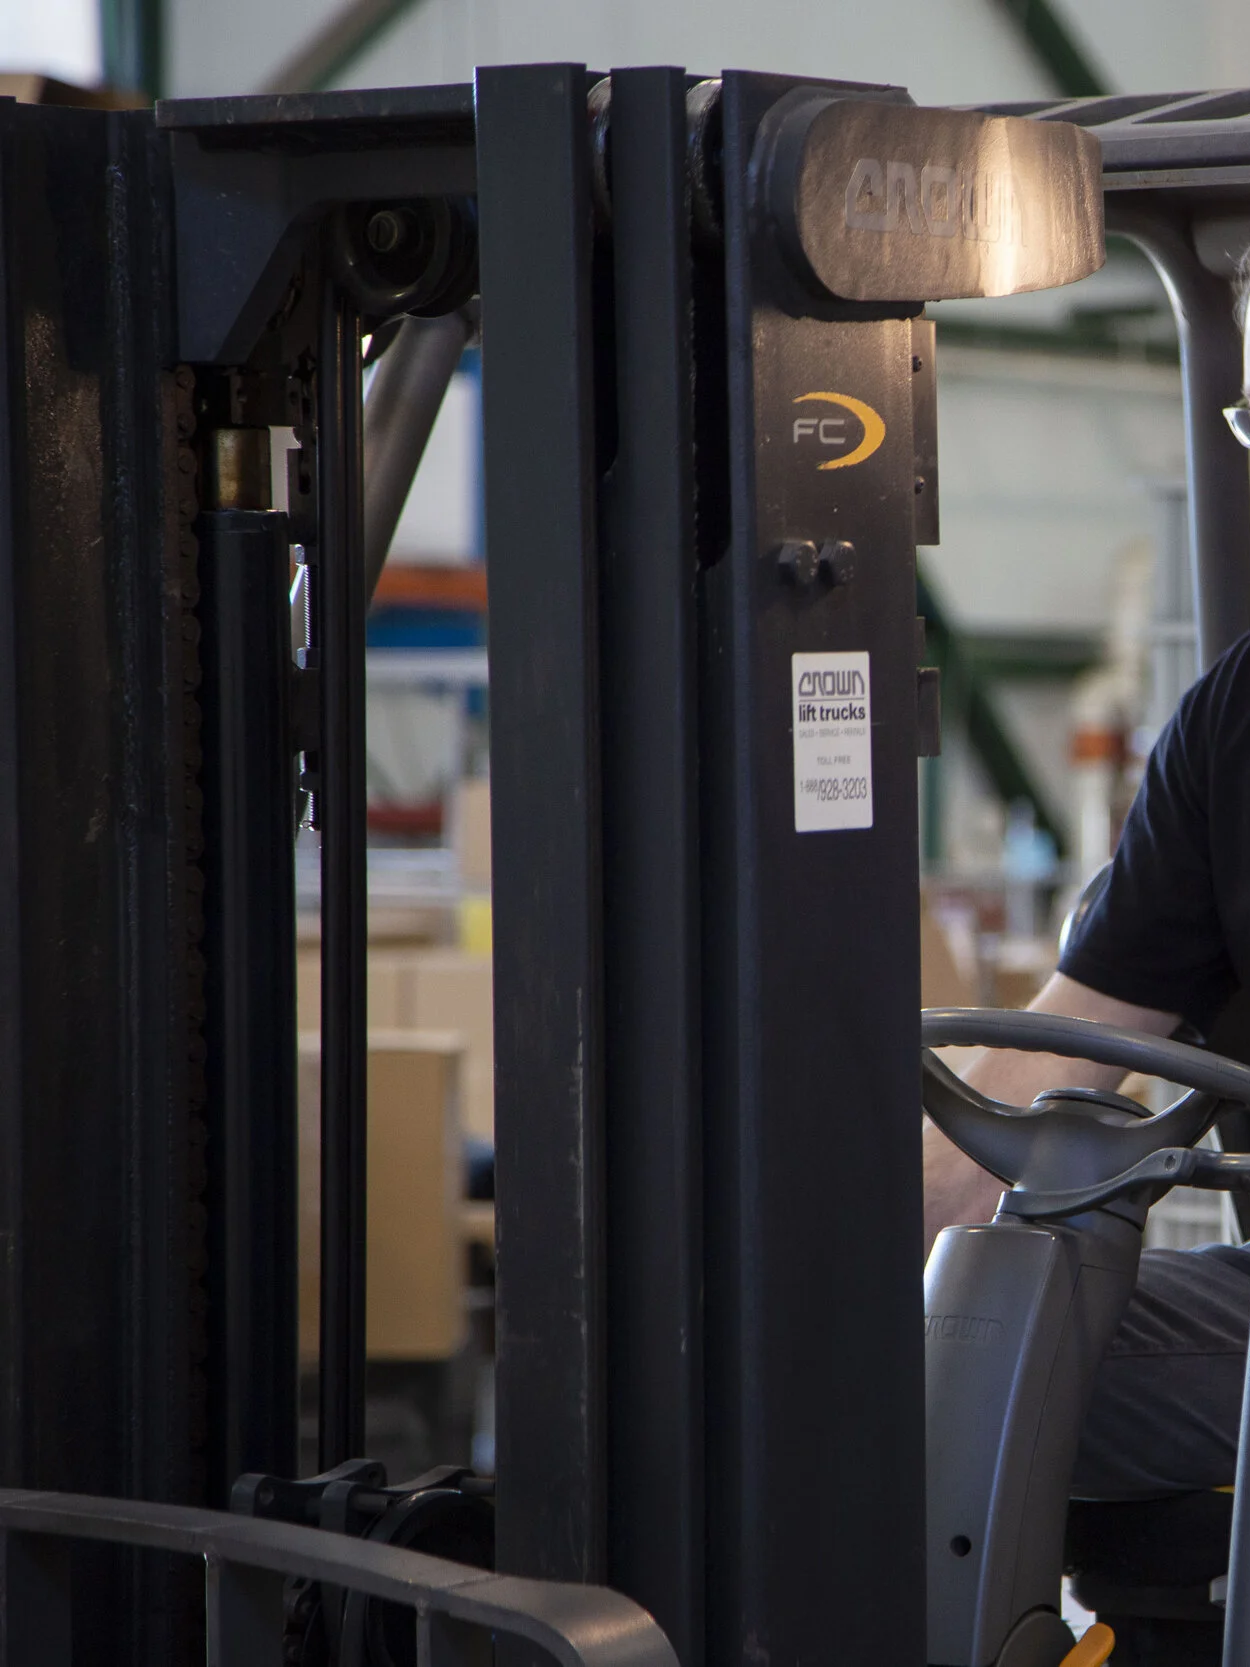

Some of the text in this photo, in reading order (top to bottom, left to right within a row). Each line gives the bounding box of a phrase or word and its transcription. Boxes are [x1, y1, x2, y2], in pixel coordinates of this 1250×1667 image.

[793, 418, 846, 444] FC
[798, 670, 865, 697] CROWN
[798, 702, 866, 722] lift trucks
[925, 1315, 1005, 1342] ROWN
